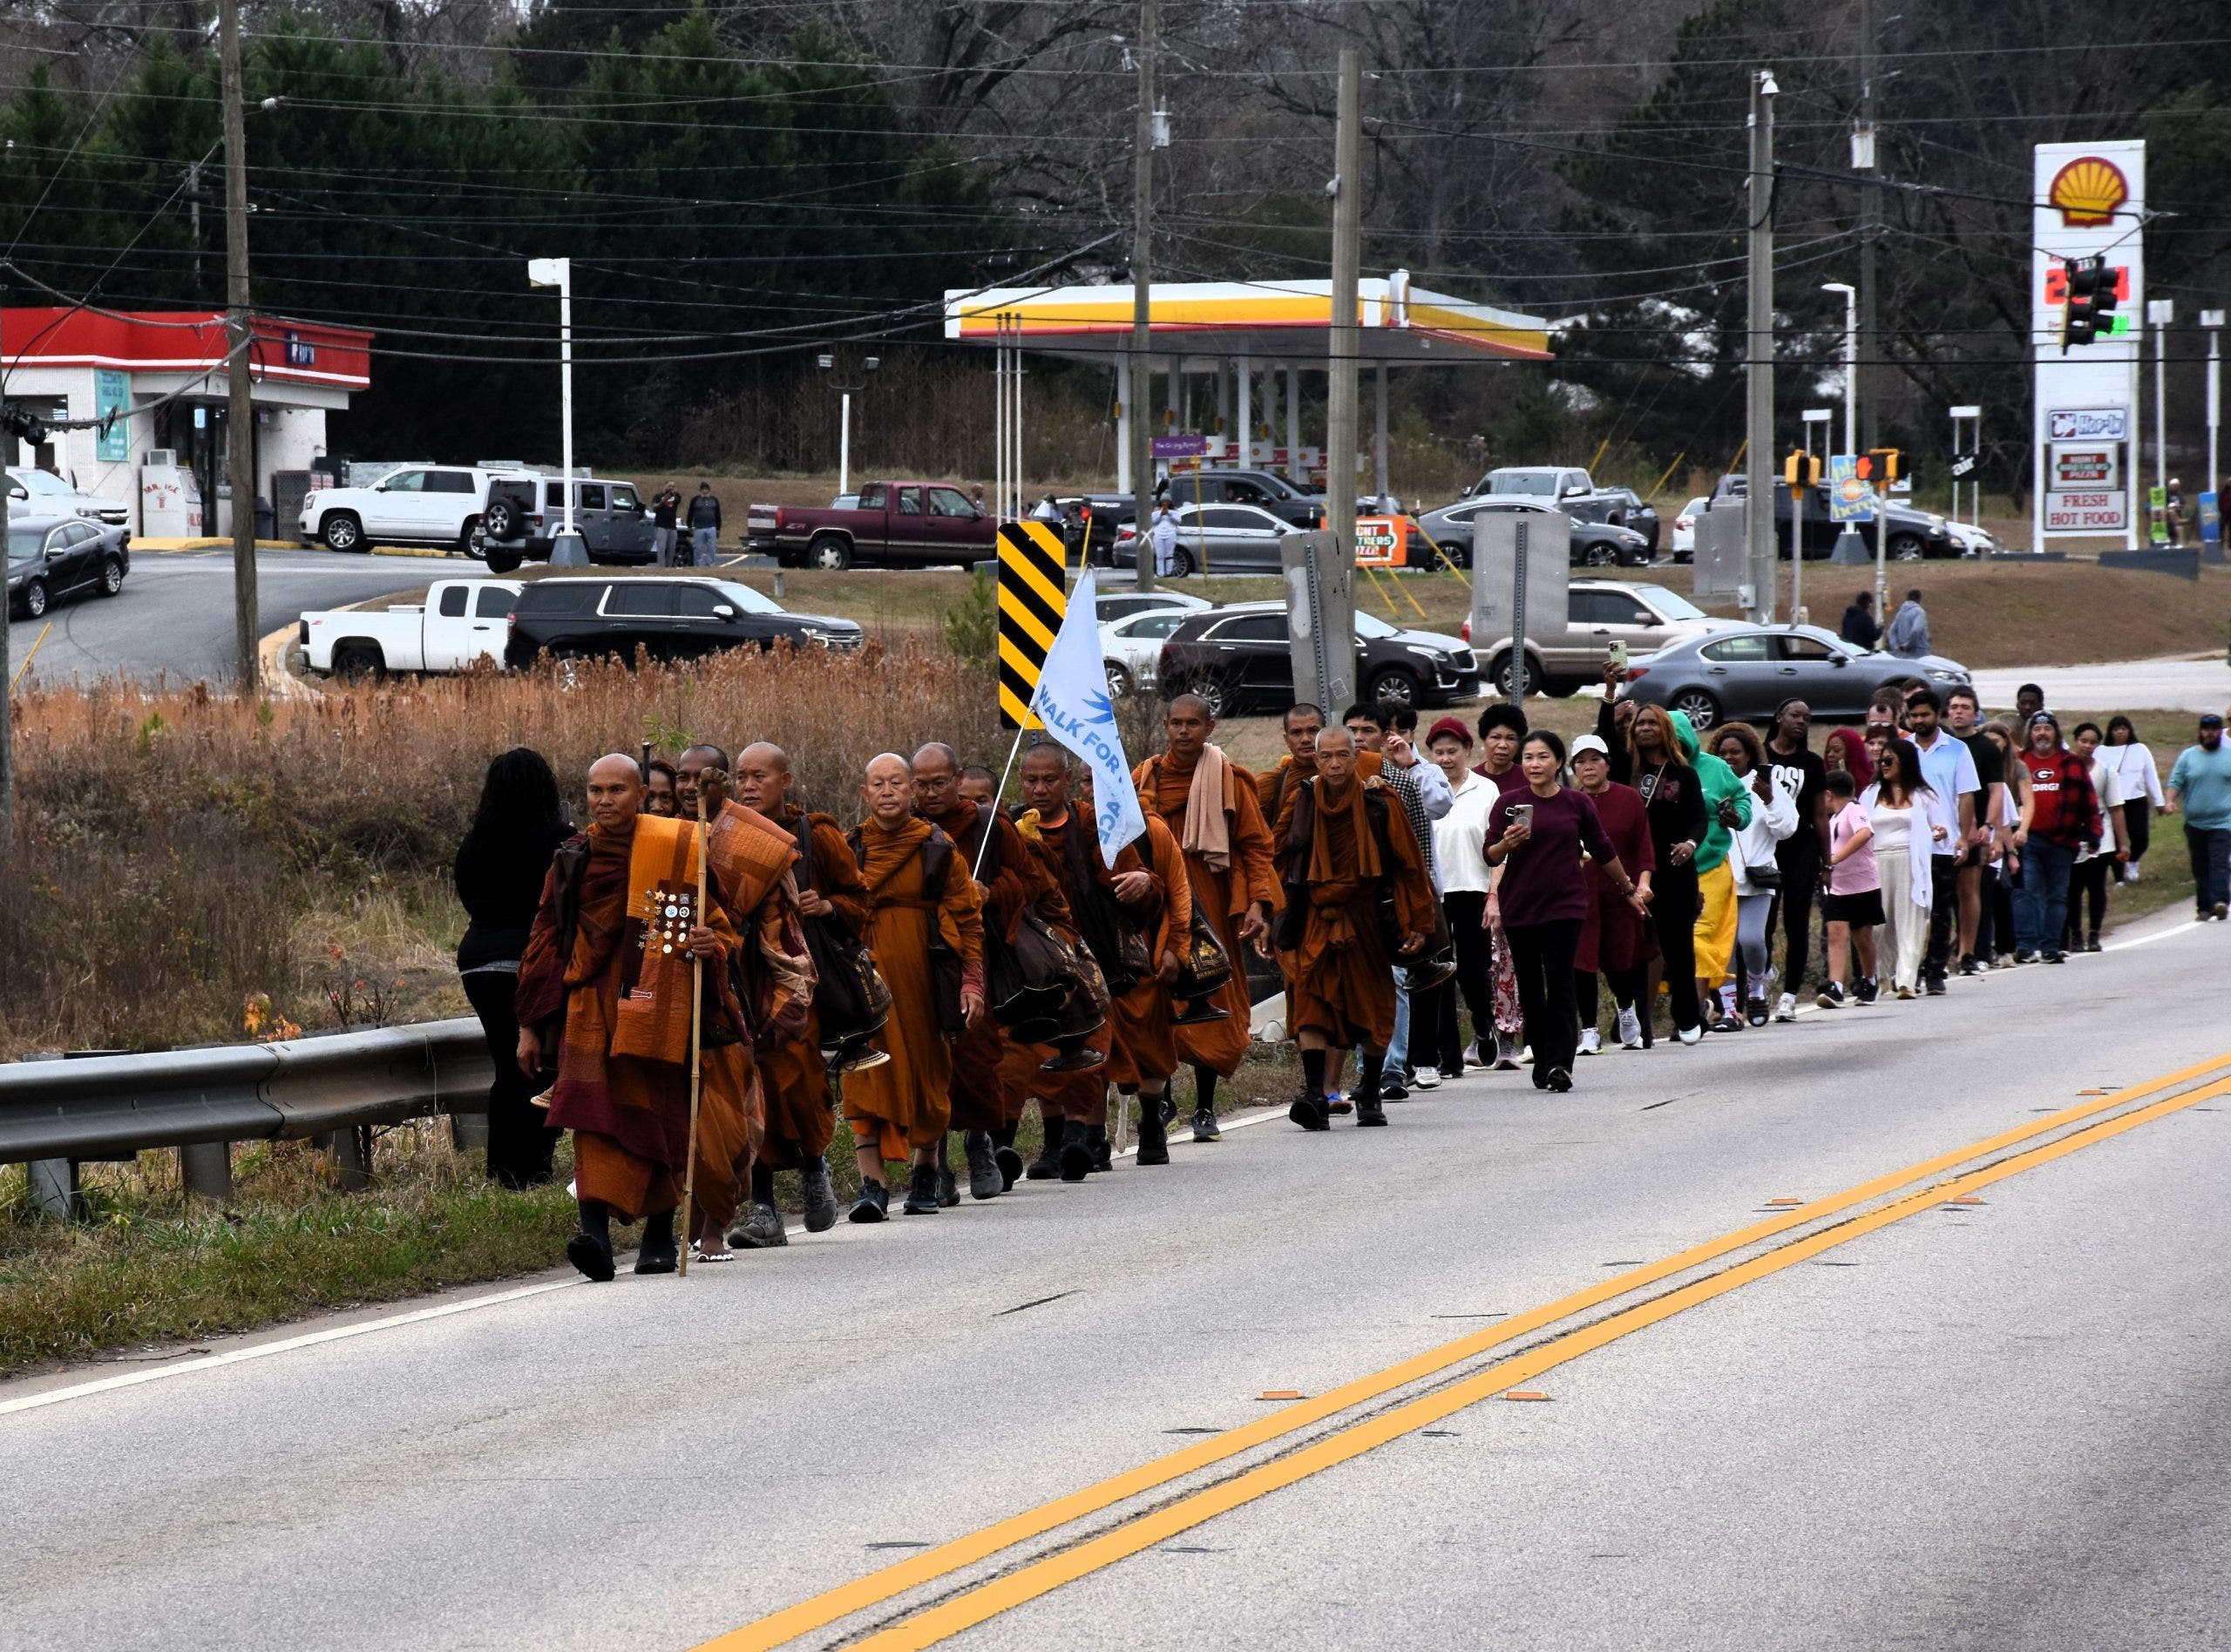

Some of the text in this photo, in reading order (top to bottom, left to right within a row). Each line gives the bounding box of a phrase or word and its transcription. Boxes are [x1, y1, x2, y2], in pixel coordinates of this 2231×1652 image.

[1952, 456, 1975, 477] air
[2063, 494, 2109, 507] FRESH
[2050, 511, 2121, 525] HOT FOOD
[1038, 684, 1085, 739] WALK
[1082, 731, 1120, 775] FOR
[2032, 782, 2060, 792] ORGI
[1098, 801, 1122, 845] ACE
